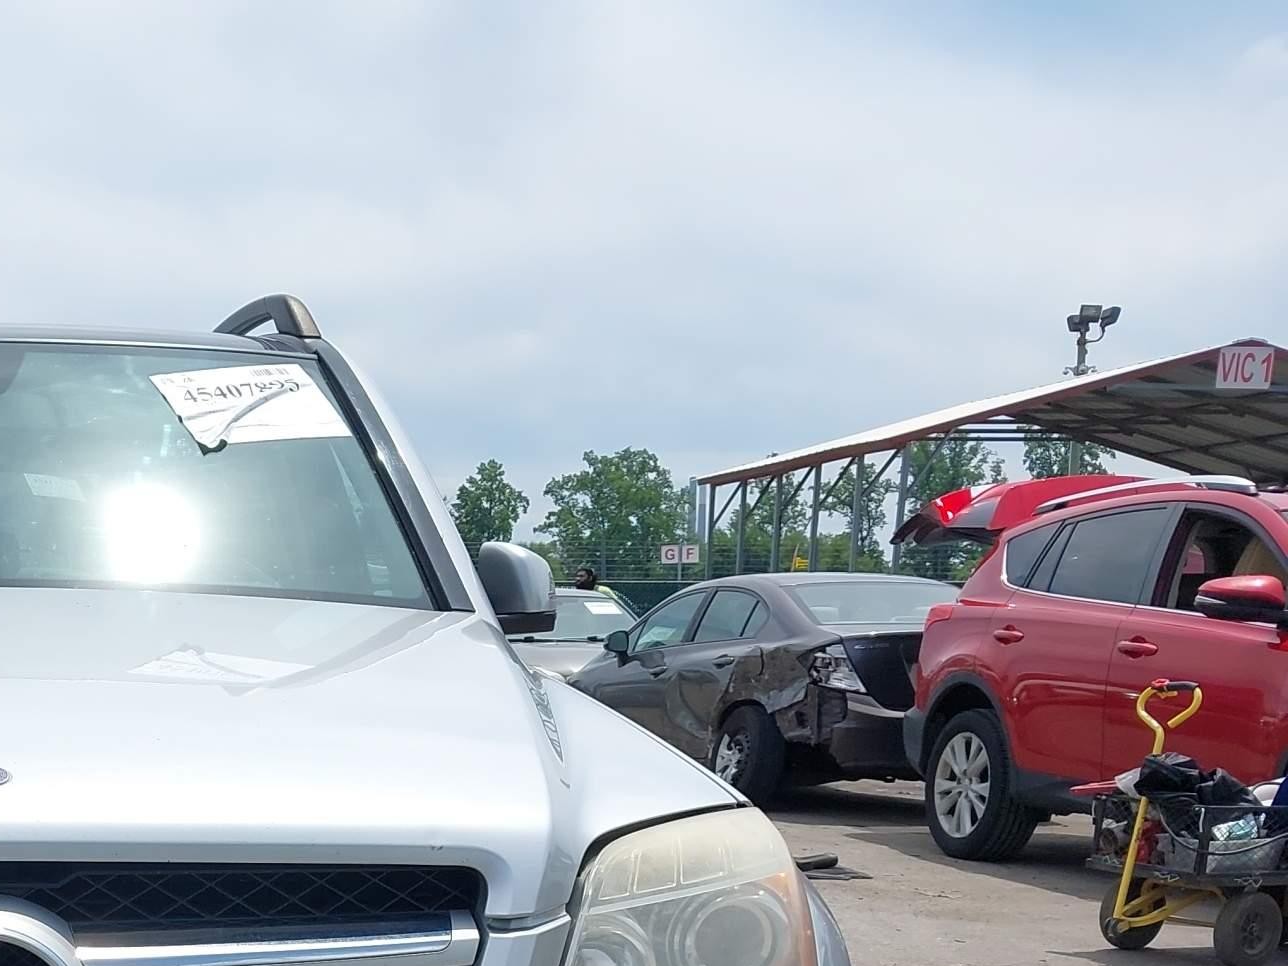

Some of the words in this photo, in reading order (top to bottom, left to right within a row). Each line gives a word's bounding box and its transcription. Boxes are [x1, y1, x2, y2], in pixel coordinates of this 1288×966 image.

[1221, 352, 1256, 383] VIC
[1261, 352, 1273, 383] 1
[664, 548, 676, 561] G
[686, 547, 696, 560] F
